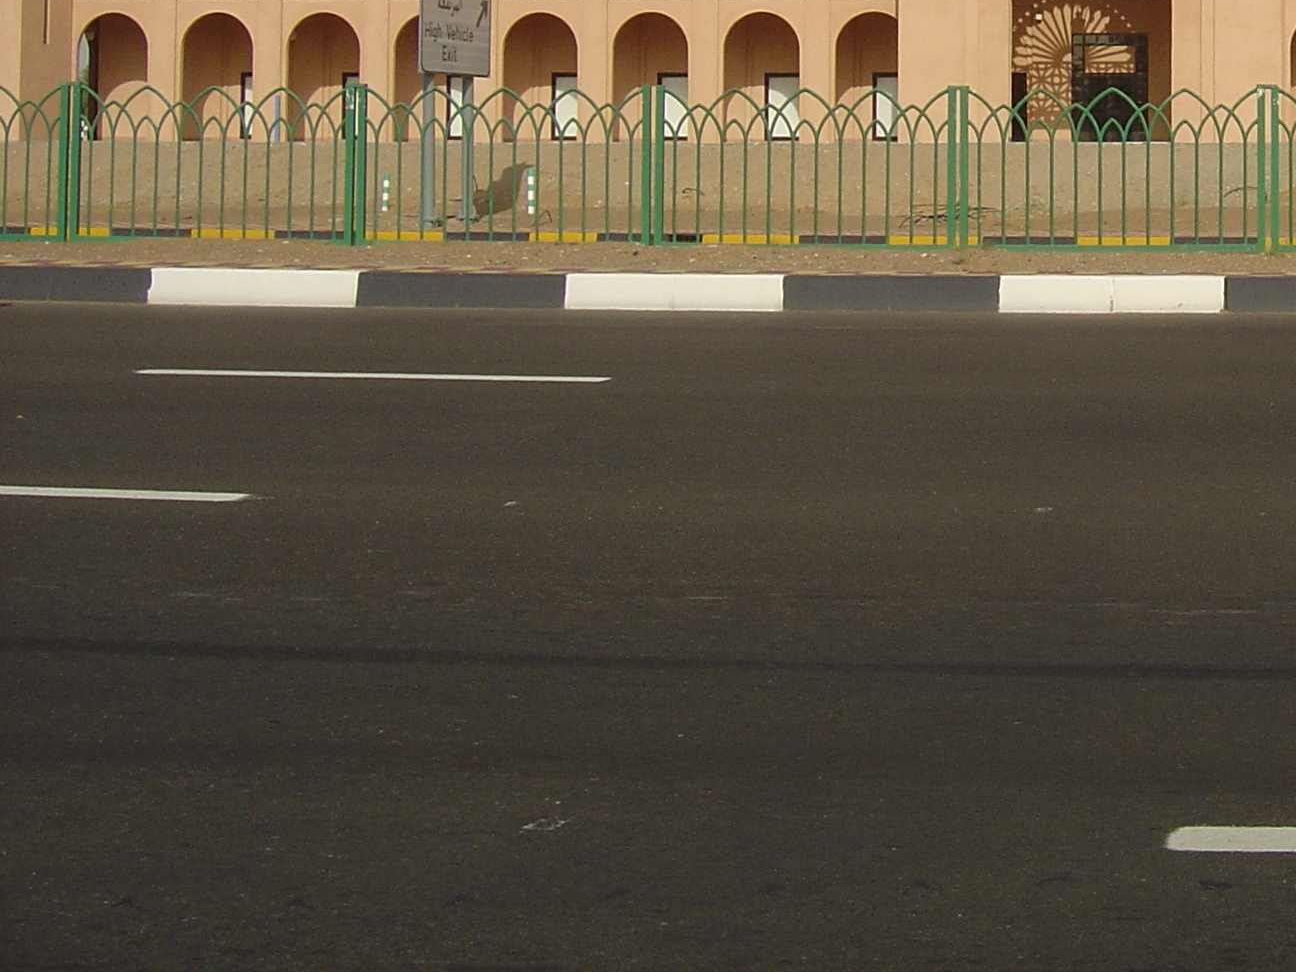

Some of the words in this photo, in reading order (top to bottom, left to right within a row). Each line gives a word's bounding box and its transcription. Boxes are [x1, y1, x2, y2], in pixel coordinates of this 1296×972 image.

[424, 22, 443, 42] High
[446, 24, 474, 42] Vehicle
[442, 45, 458, 62] Exit
